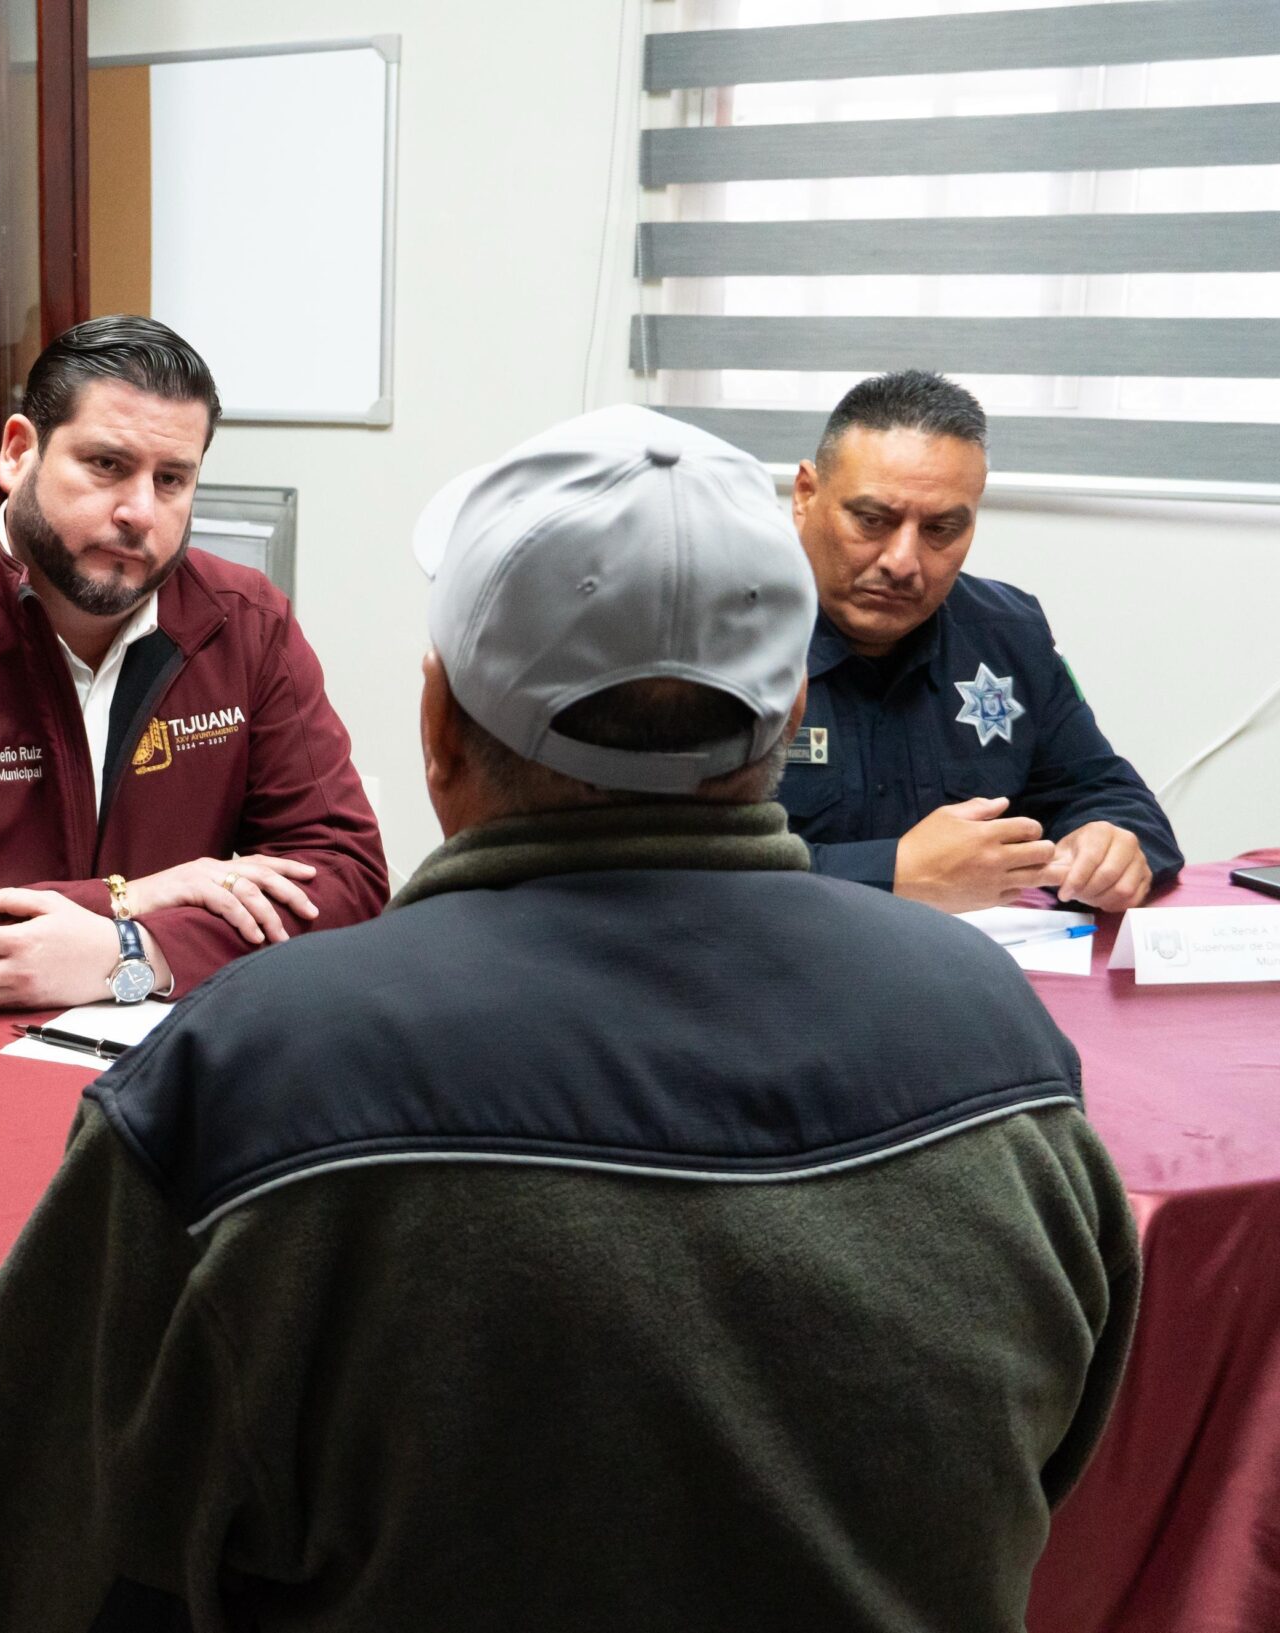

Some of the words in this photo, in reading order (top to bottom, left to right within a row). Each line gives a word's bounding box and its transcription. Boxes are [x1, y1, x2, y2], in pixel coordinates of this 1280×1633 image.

[167, 706, 245, 736] TIJUANA
[175, 734, 190, 744] XXV
[191, 725, 239, 741] AYUNTAMIENTO
[19, 745, 42, 760] Ruiz
